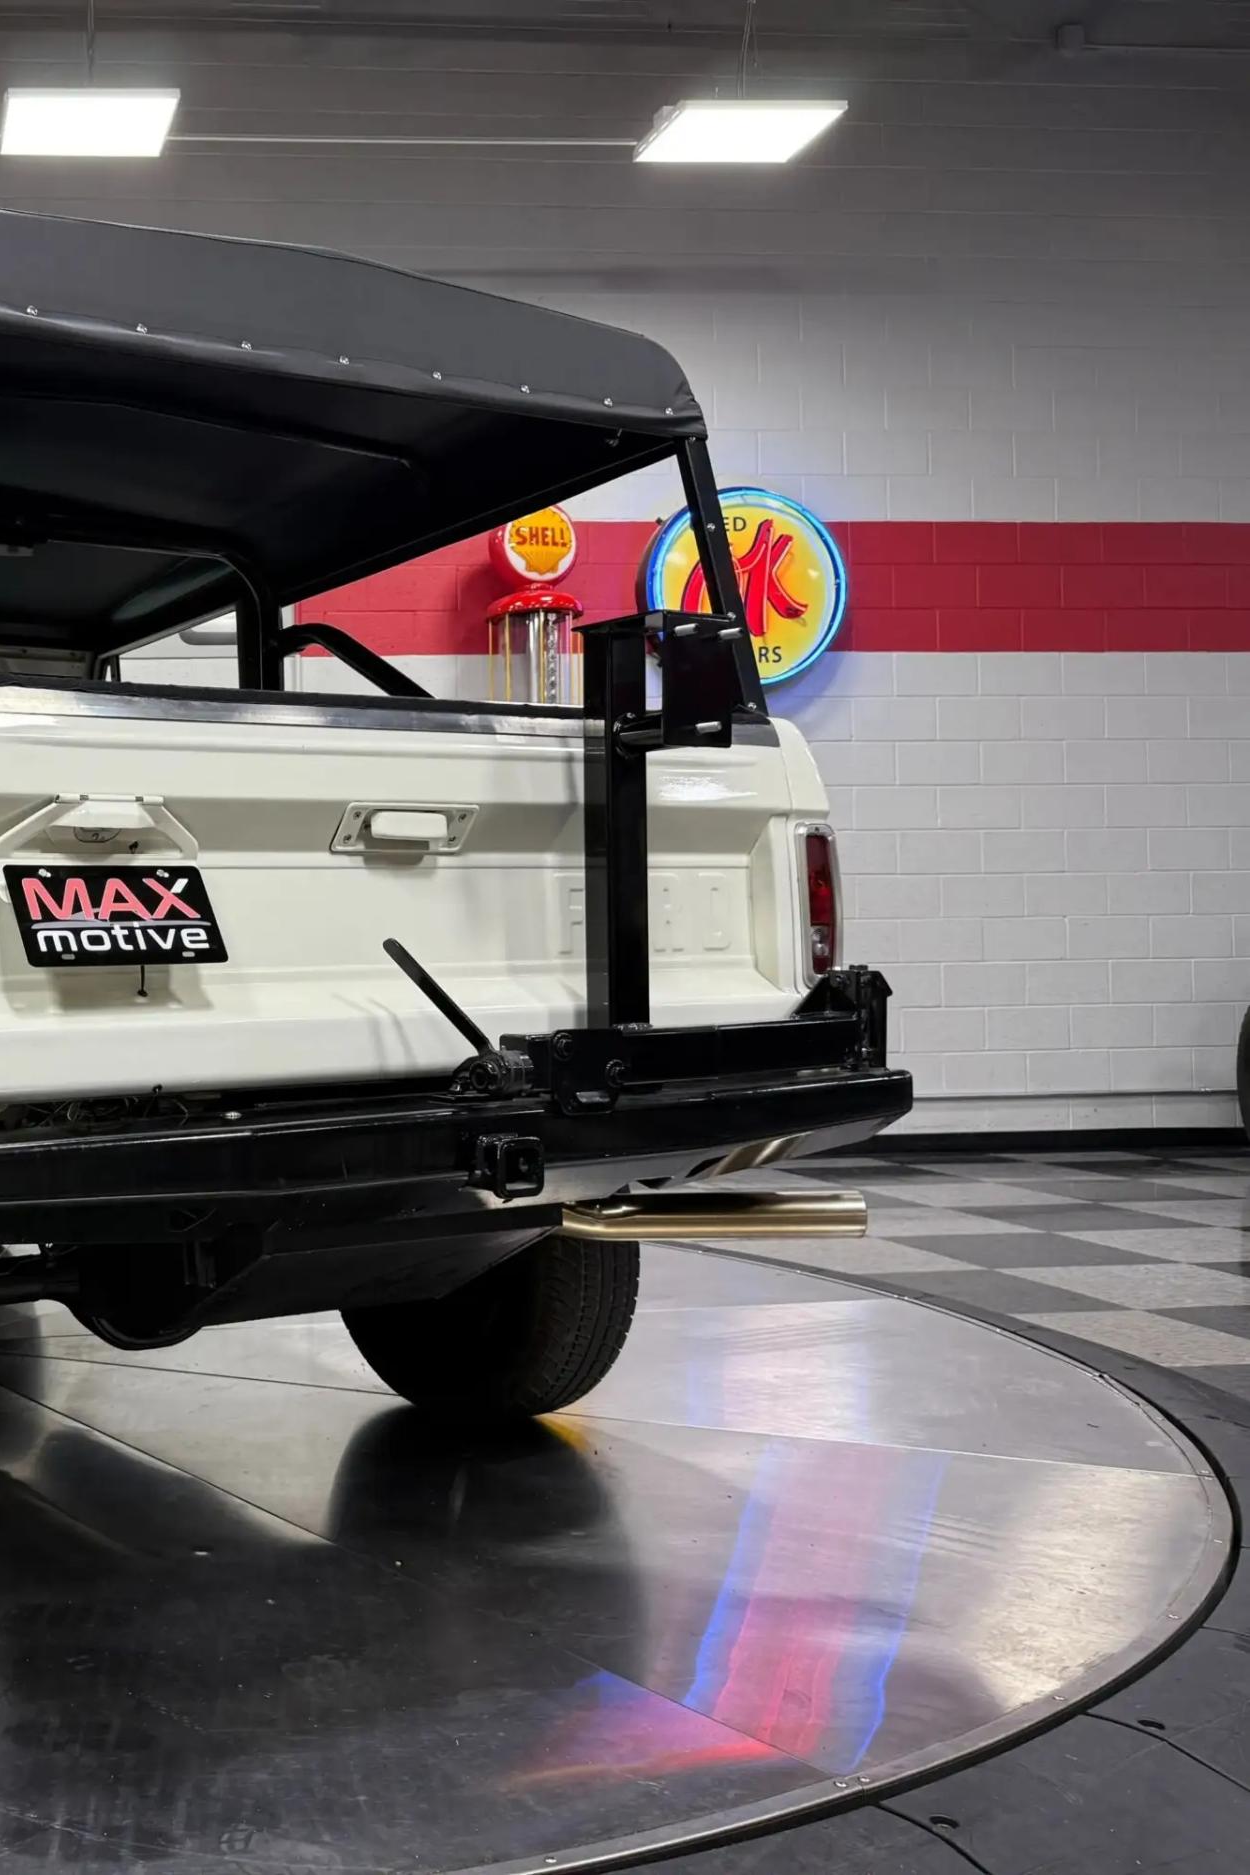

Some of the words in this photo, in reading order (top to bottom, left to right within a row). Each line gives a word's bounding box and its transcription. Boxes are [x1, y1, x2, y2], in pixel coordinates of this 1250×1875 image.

[515, 526, 568, 547] SHELL
[21, 878, 201, 921] MAX
[37, 922, 211, 952] motive
